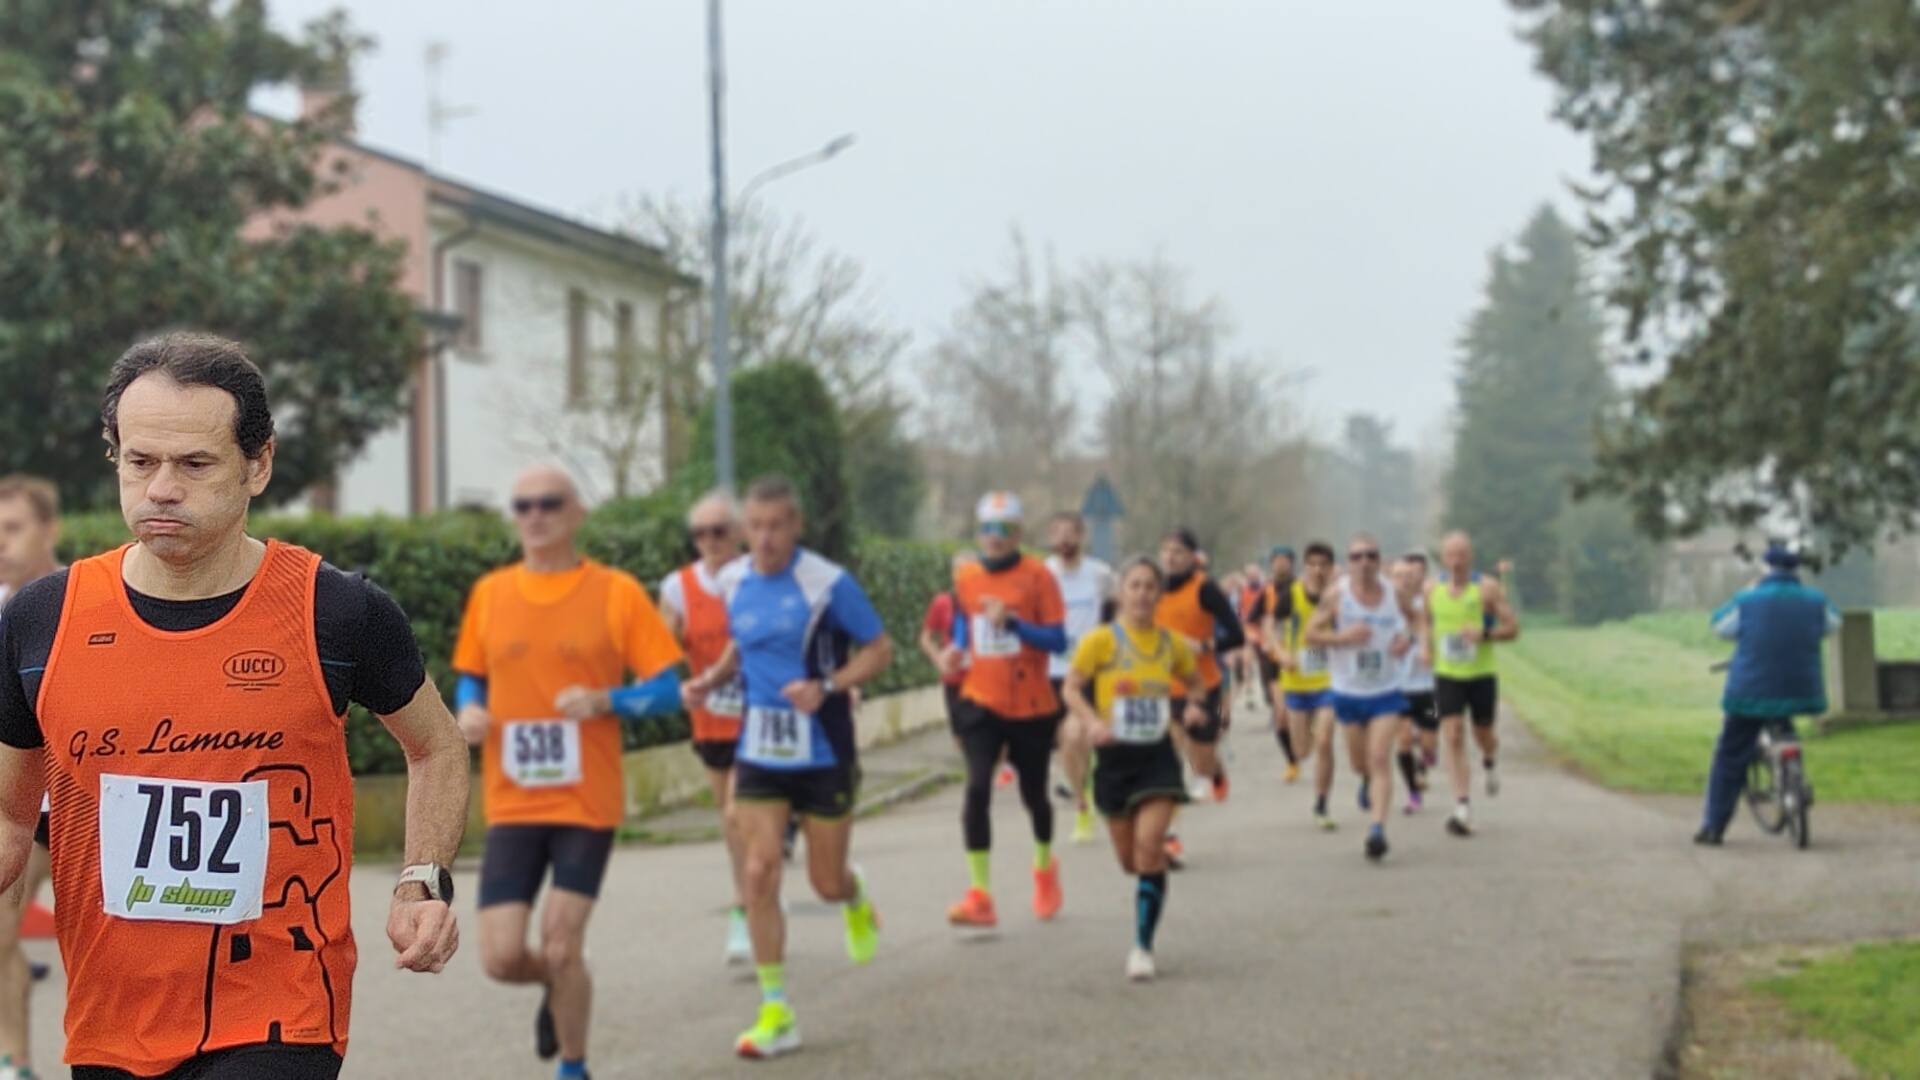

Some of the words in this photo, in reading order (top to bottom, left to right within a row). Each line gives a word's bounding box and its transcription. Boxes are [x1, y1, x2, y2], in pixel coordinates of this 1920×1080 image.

[232, 658, 276, 674] LUCCI
[69, 727, 125, 765] G.S.
[137, 718, 284, 755] Lamone
[514, 723, 564, 763] 538
[134, 783, 242, 874] 752
[184, 906, 225, 914] SPORT
